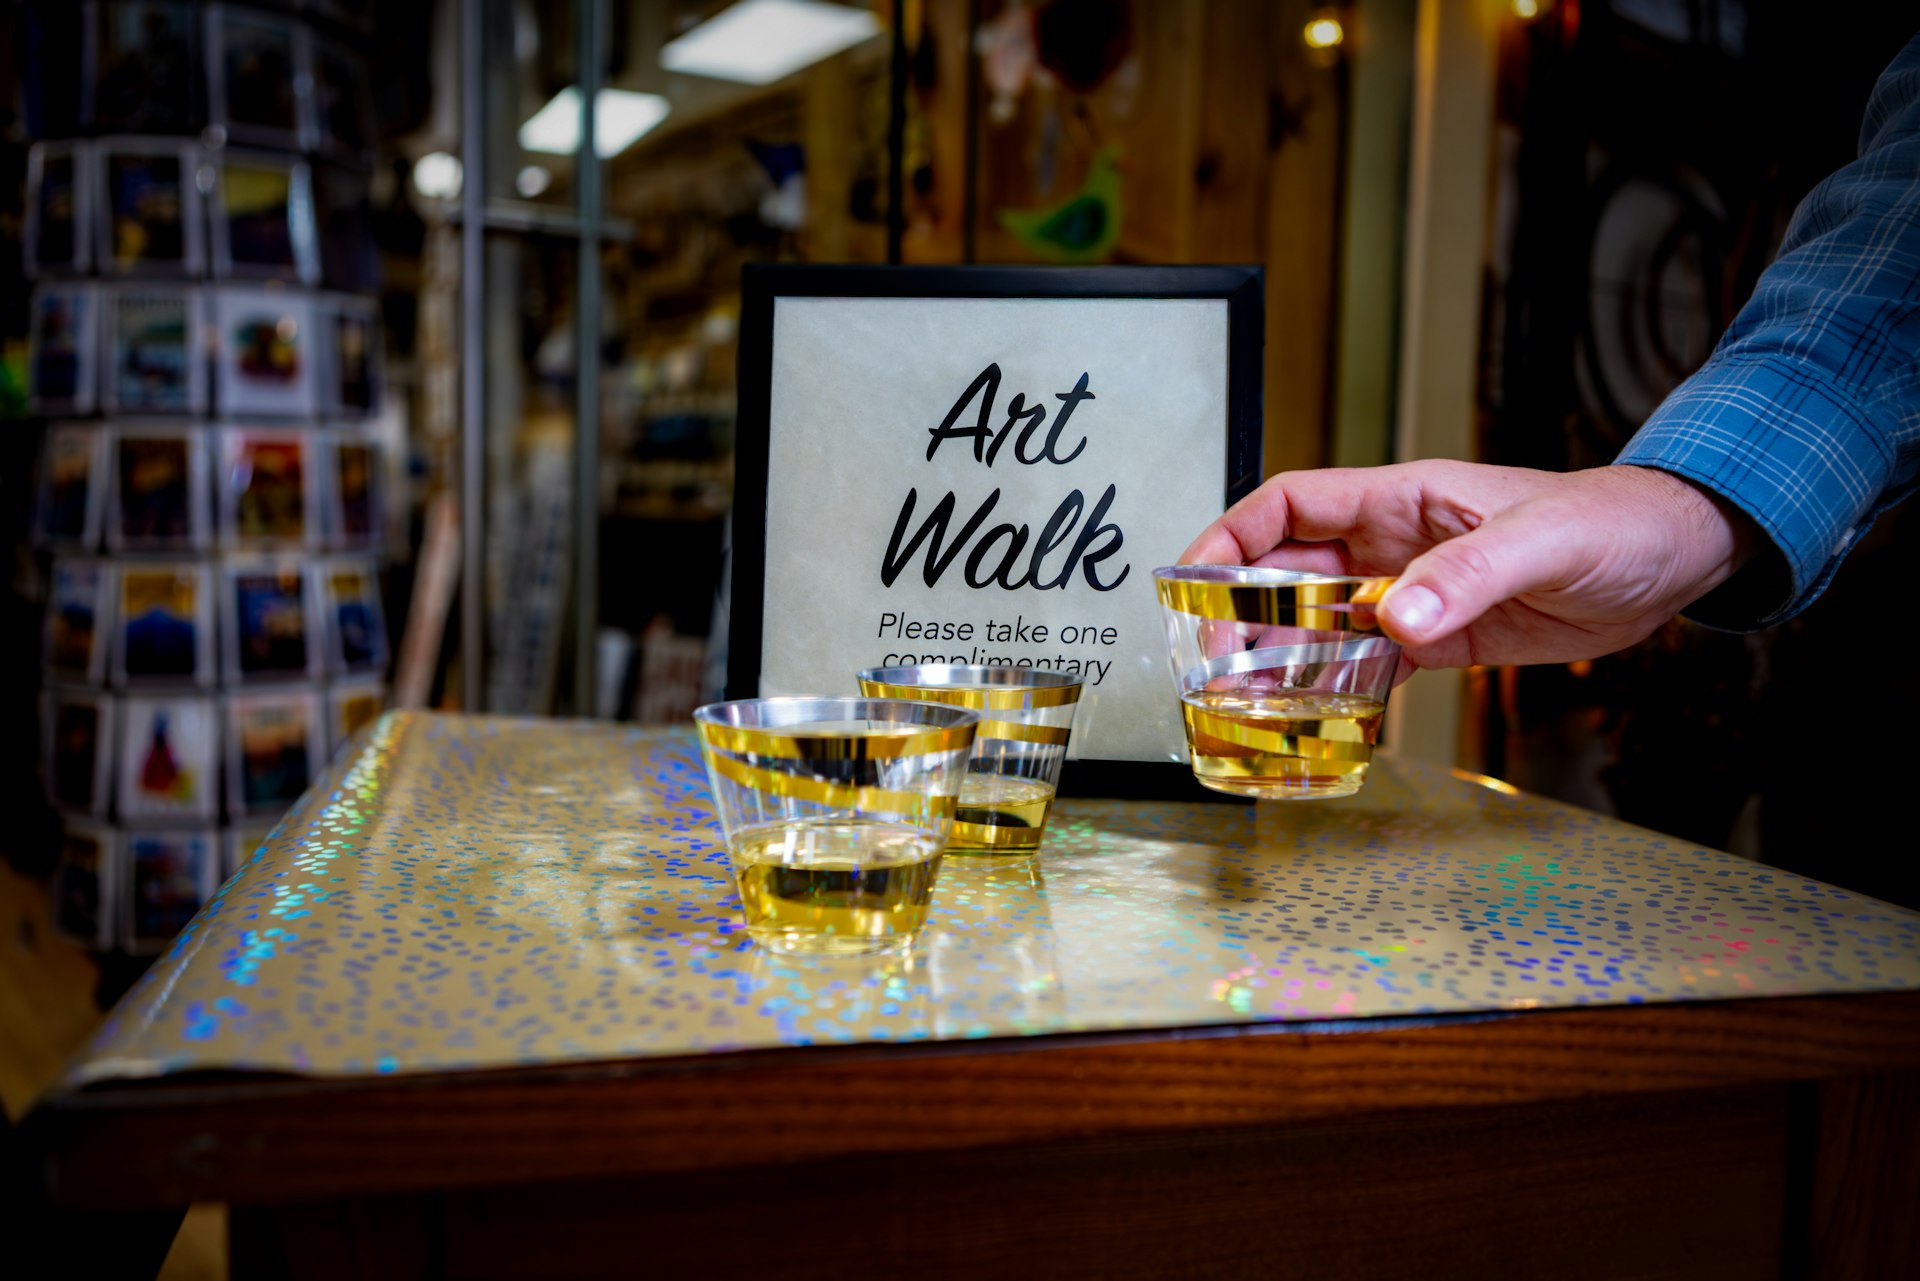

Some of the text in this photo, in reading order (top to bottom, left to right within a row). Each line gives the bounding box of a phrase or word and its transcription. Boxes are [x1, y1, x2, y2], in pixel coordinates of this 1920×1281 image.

[926, 362, 1096, 468] Art
[881, 483, 1130, 592] Walk
[878, 612, 1118, 645] Please take one
[883, 647, 1112, 686] comlimentary
